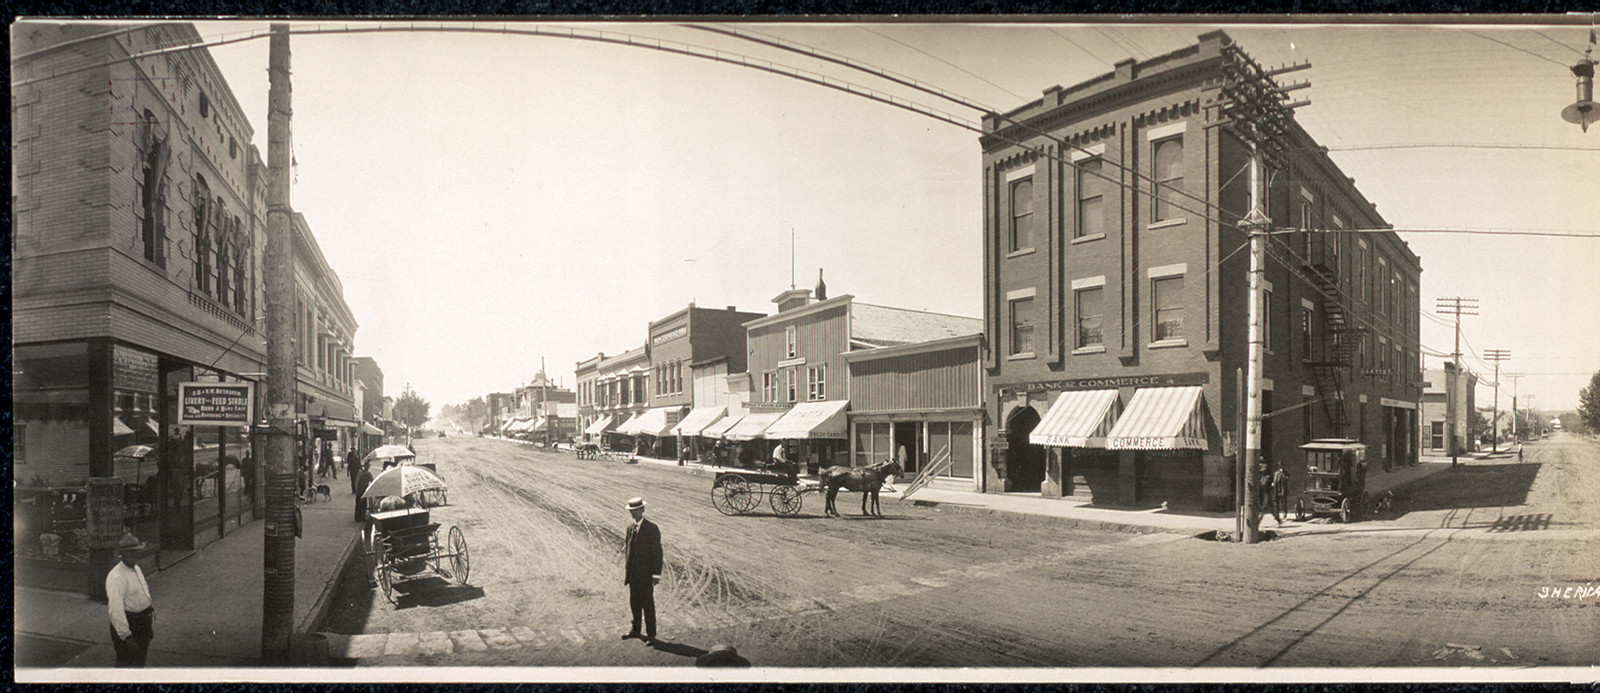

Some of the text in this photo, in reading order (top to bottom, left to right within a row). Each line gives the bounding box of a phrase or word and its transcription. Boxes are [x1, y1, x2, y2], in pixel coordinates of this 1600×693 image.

[1028, 382, 1062, 390] BANK
[1078, 376, 1159, 387] COMMERCE
[185, 396, 206, 405] LIVERY
[211, 397, 227, 405] FEED
[227, 397, 248, 405] STABLE
[1046, 436, 1070, 444] BANK
[1112, 437, 1164, 447] COMMERCE
[1183, 437, 1202, 447] BANK
